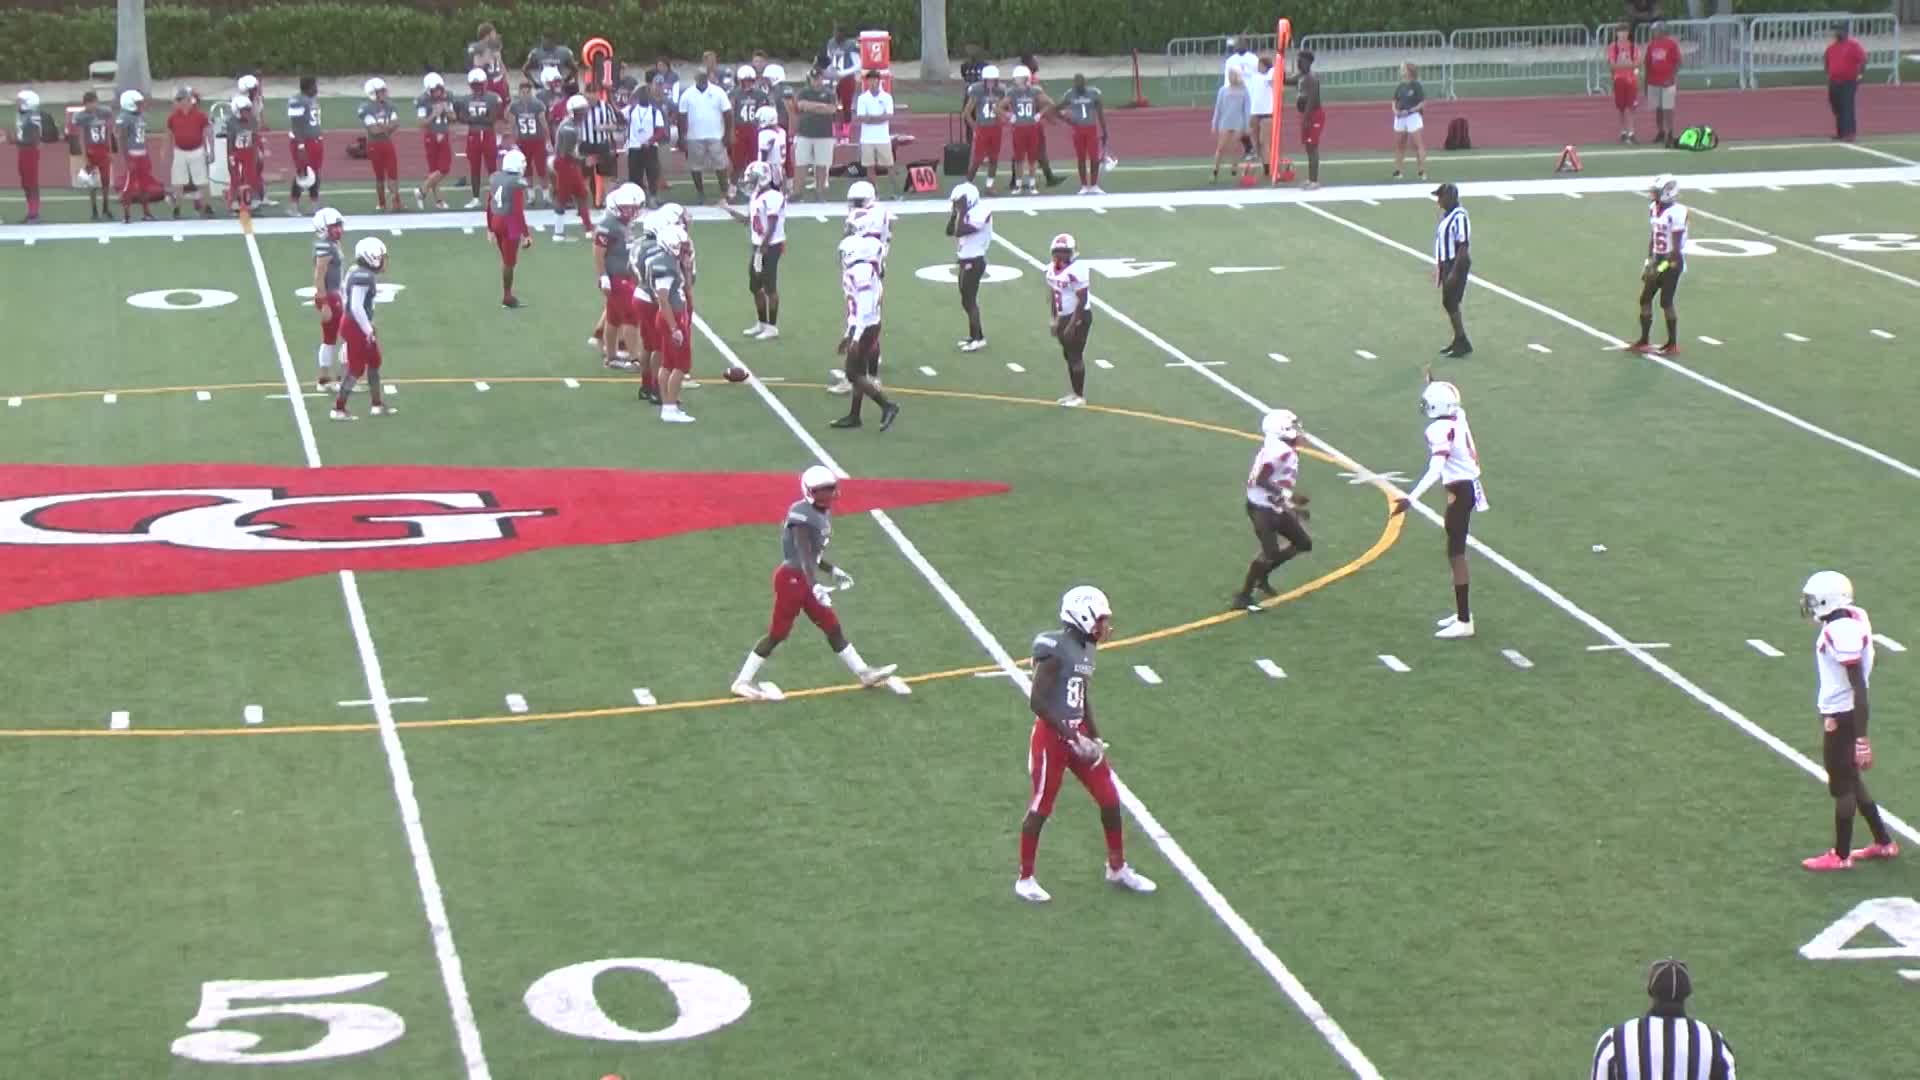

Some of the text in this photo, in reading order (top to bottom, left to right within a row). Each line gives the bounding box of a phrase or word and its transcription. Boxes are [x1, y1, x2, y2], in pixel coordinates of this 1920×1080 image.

[740, 104, 757, 122] 46
[1016, 102, 1034, 118] 30
[1080, 102, 1088, 119] 1
[517, 117, 538, 135] 59
[915, 168, 934, 187] 40
[494, 185, 504, 209] 4
